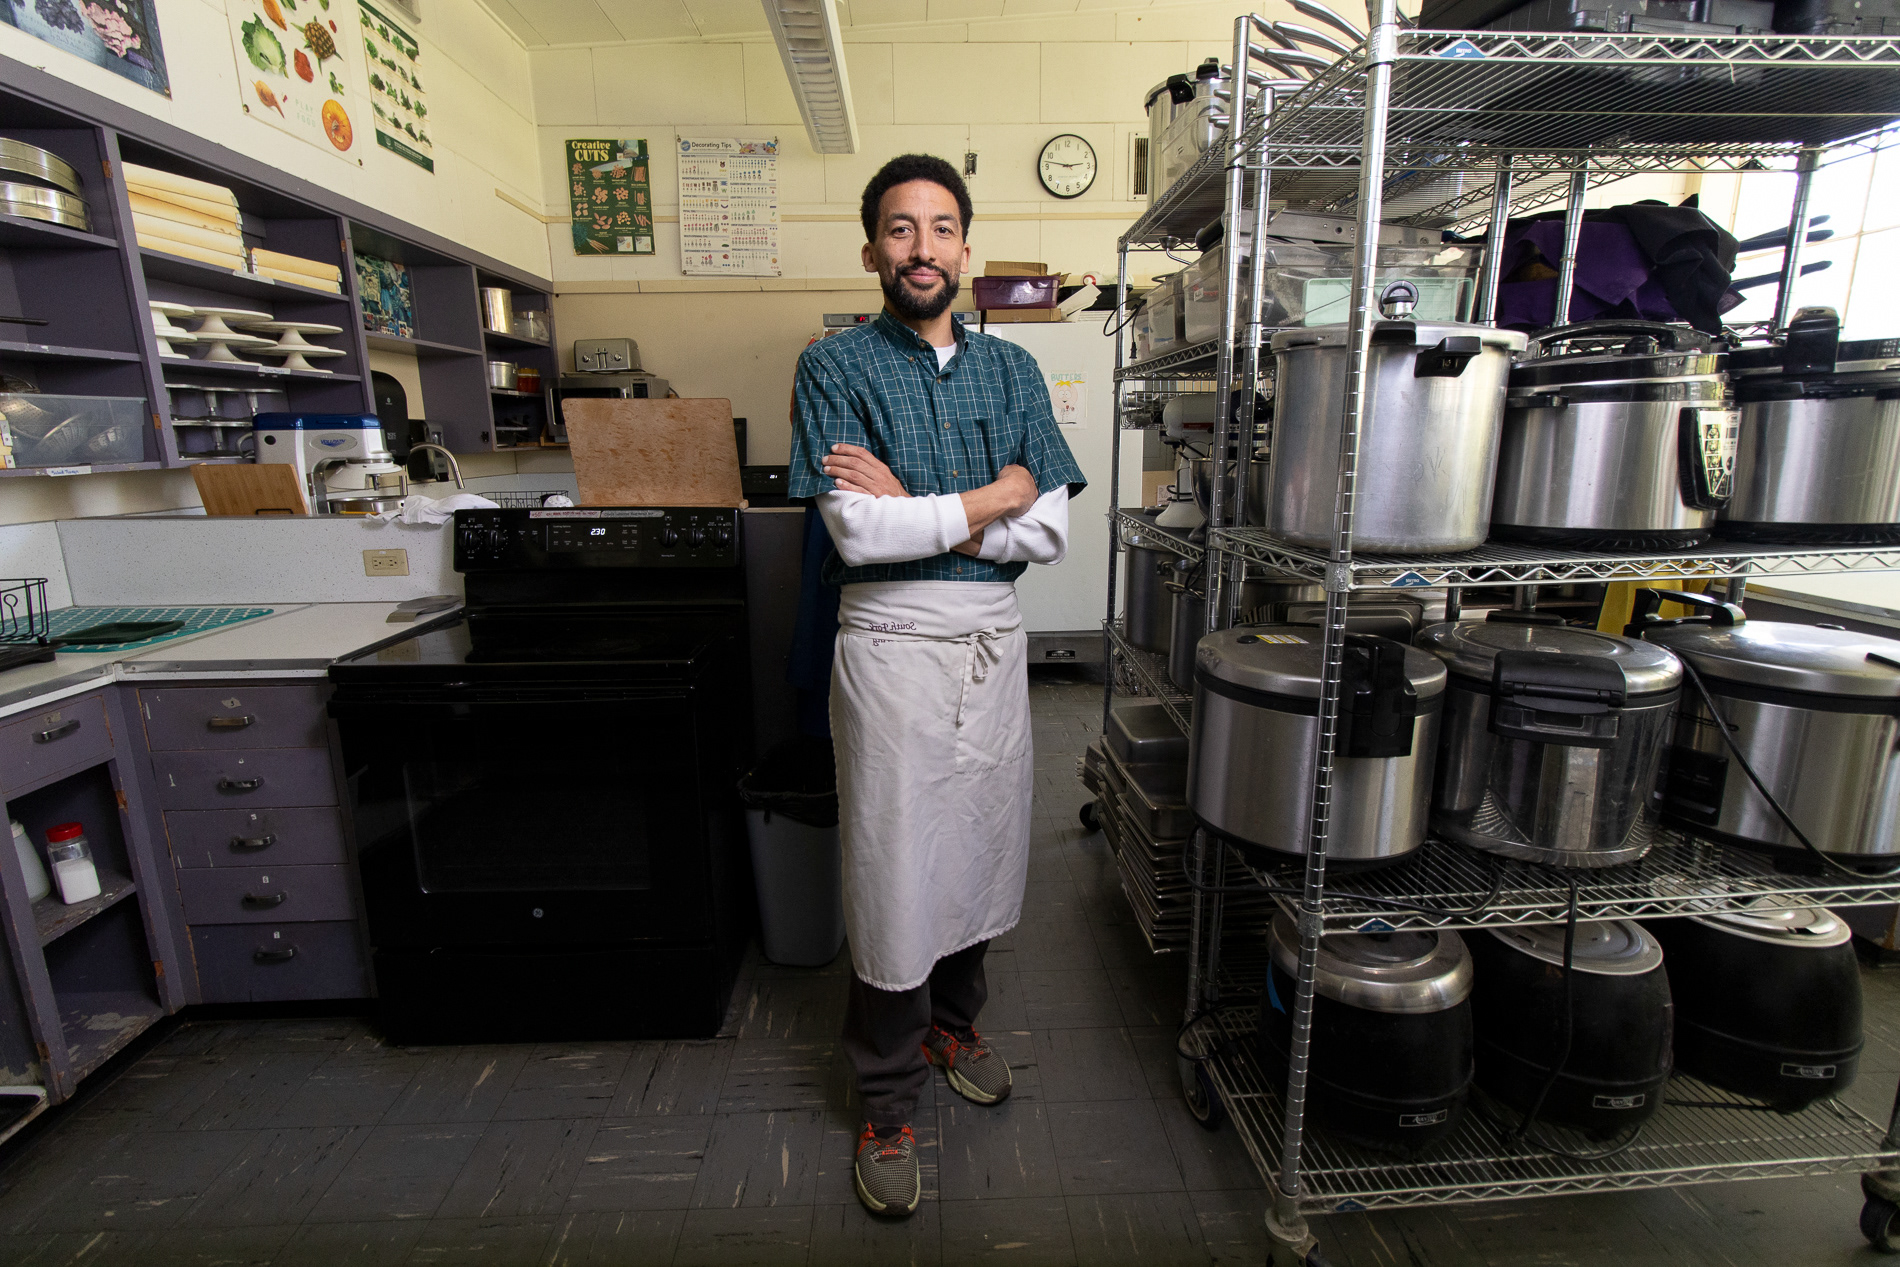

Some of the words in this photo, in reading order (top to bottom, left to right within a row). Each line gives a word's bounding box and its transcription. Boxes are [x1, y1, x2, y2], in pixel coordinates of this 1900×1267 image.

[572, 141, 611, 150] Creative
[574, 150, 610, 162] CUTS
[1051, 373, 1082, 381] BUTTERS
